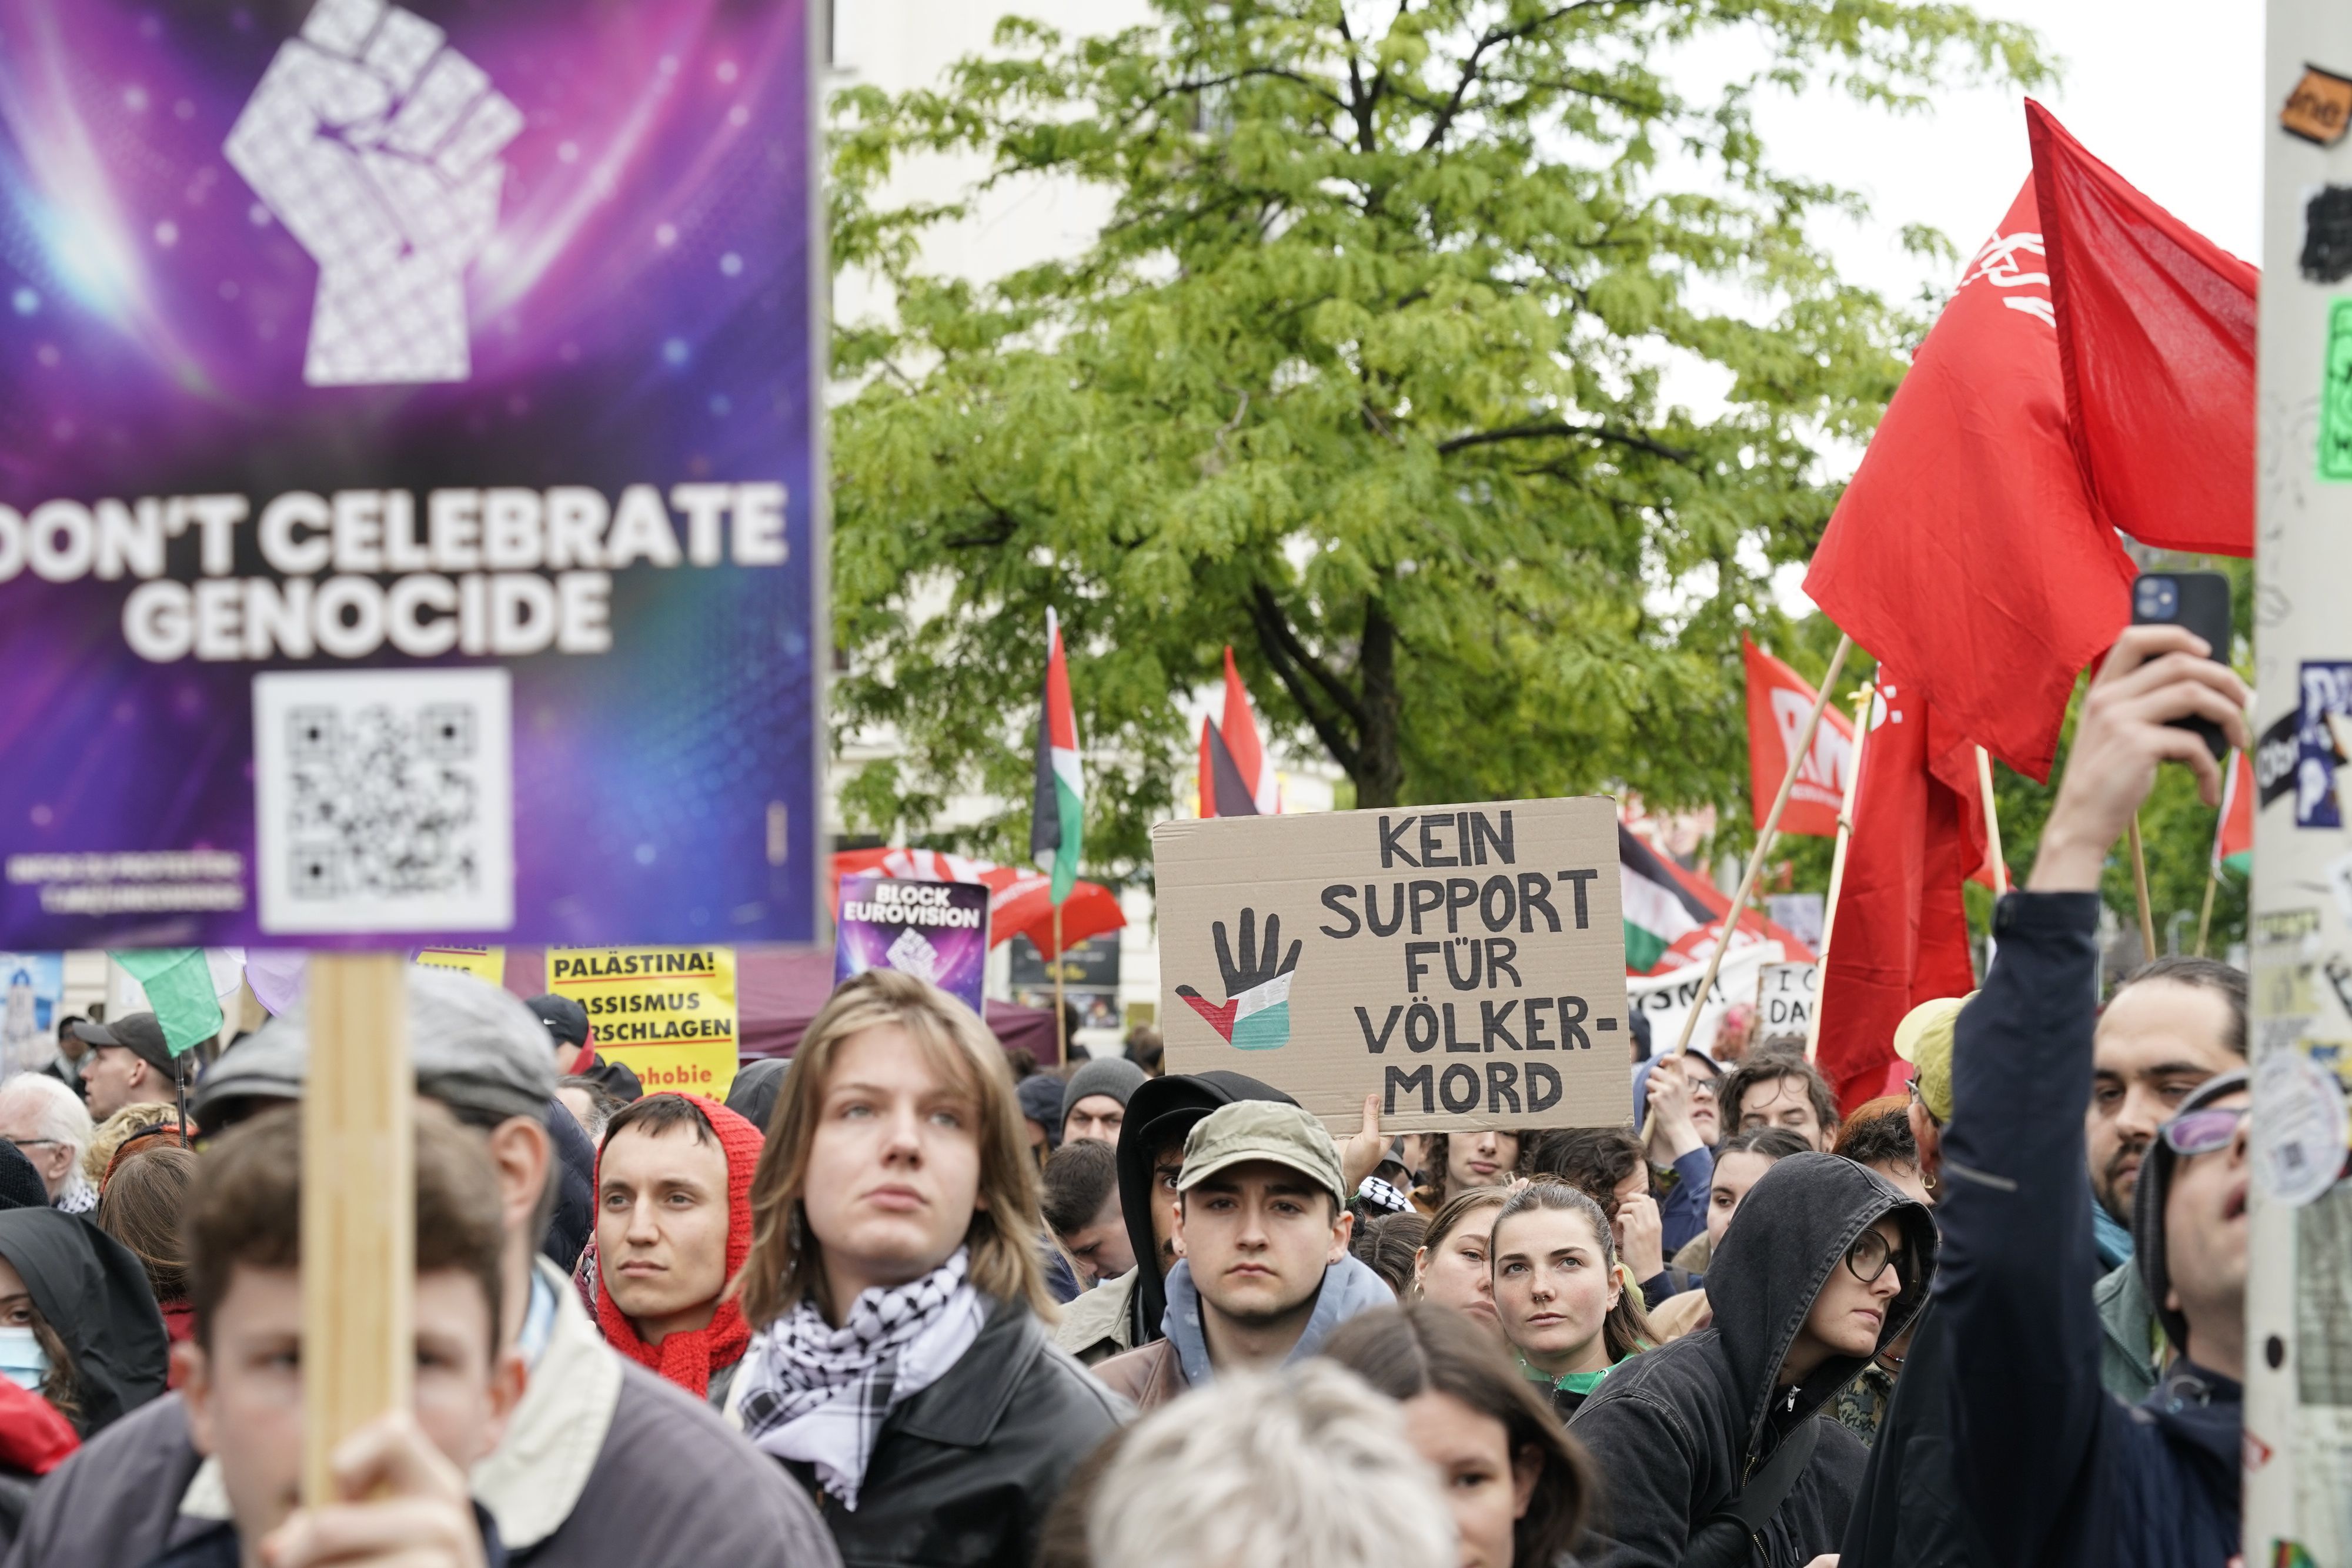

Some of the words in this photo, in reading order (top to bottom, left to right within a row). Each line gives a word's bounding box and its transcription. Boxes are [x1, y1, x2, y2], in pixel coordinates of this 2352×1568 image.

[258, 483, 788, 573] CELEBRATE
[123, 571, 612, 661] GENOCIDE
[1379, 810, 1515, 868] KEIN
[844, 901, 980, 928] EUROVISION
[876, 884, 951, 907] BLOCK
[1319, 869, 1598, 939] SUPPORT
[554, 950, 714, 978] PALÄSTINA!
[1405, 937, 1522, 992] FÜR
[1780, 970, 1791, 991] I
[576, 992, 700, 1015] ASSISMUS
[590, 1018, 731, 1042] RSCHLAGEN
[1354, 996, 1618, 1054] VÖLKER-
[1384, 1062, 1563, 1115] MORD
